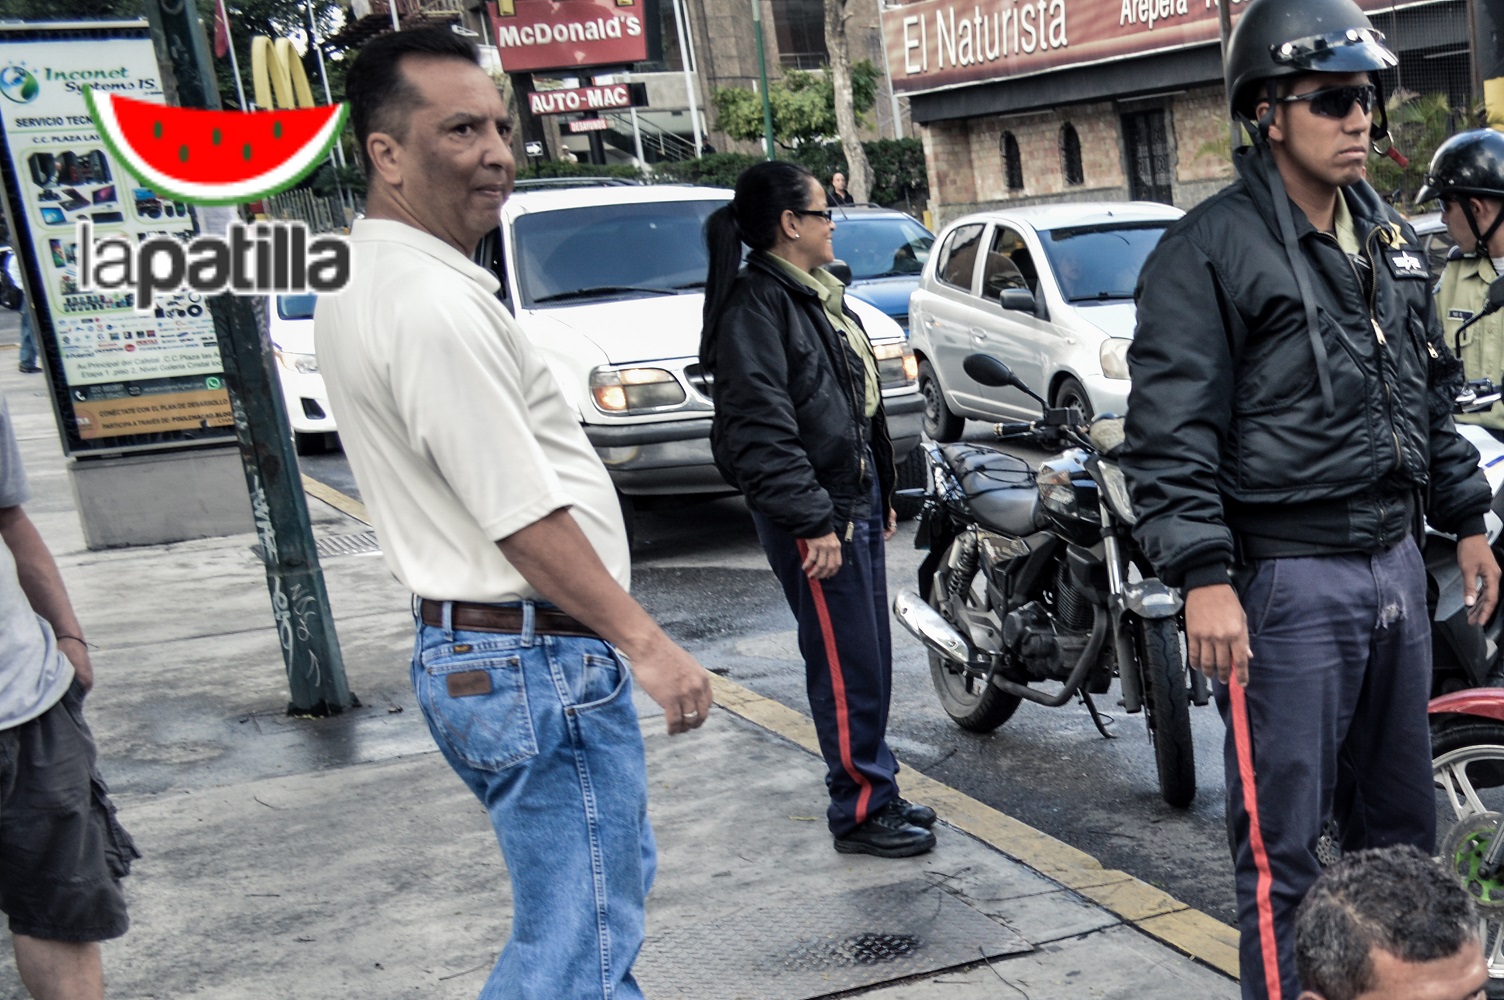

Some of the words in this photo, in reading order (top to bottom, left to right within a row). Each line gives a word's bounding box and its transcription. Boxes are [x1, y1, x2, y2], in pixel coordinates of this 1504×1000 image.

[499, 16, 642, 48] McDonald's
[903, 13, 927, 74] El
[936, 0, 1069, 69] Naturista
[44, 67, 130, 81] Inconet
[531, 87, 628, 114] AUTO-MAC
[15, 117, 64, 128] SERVICIO
